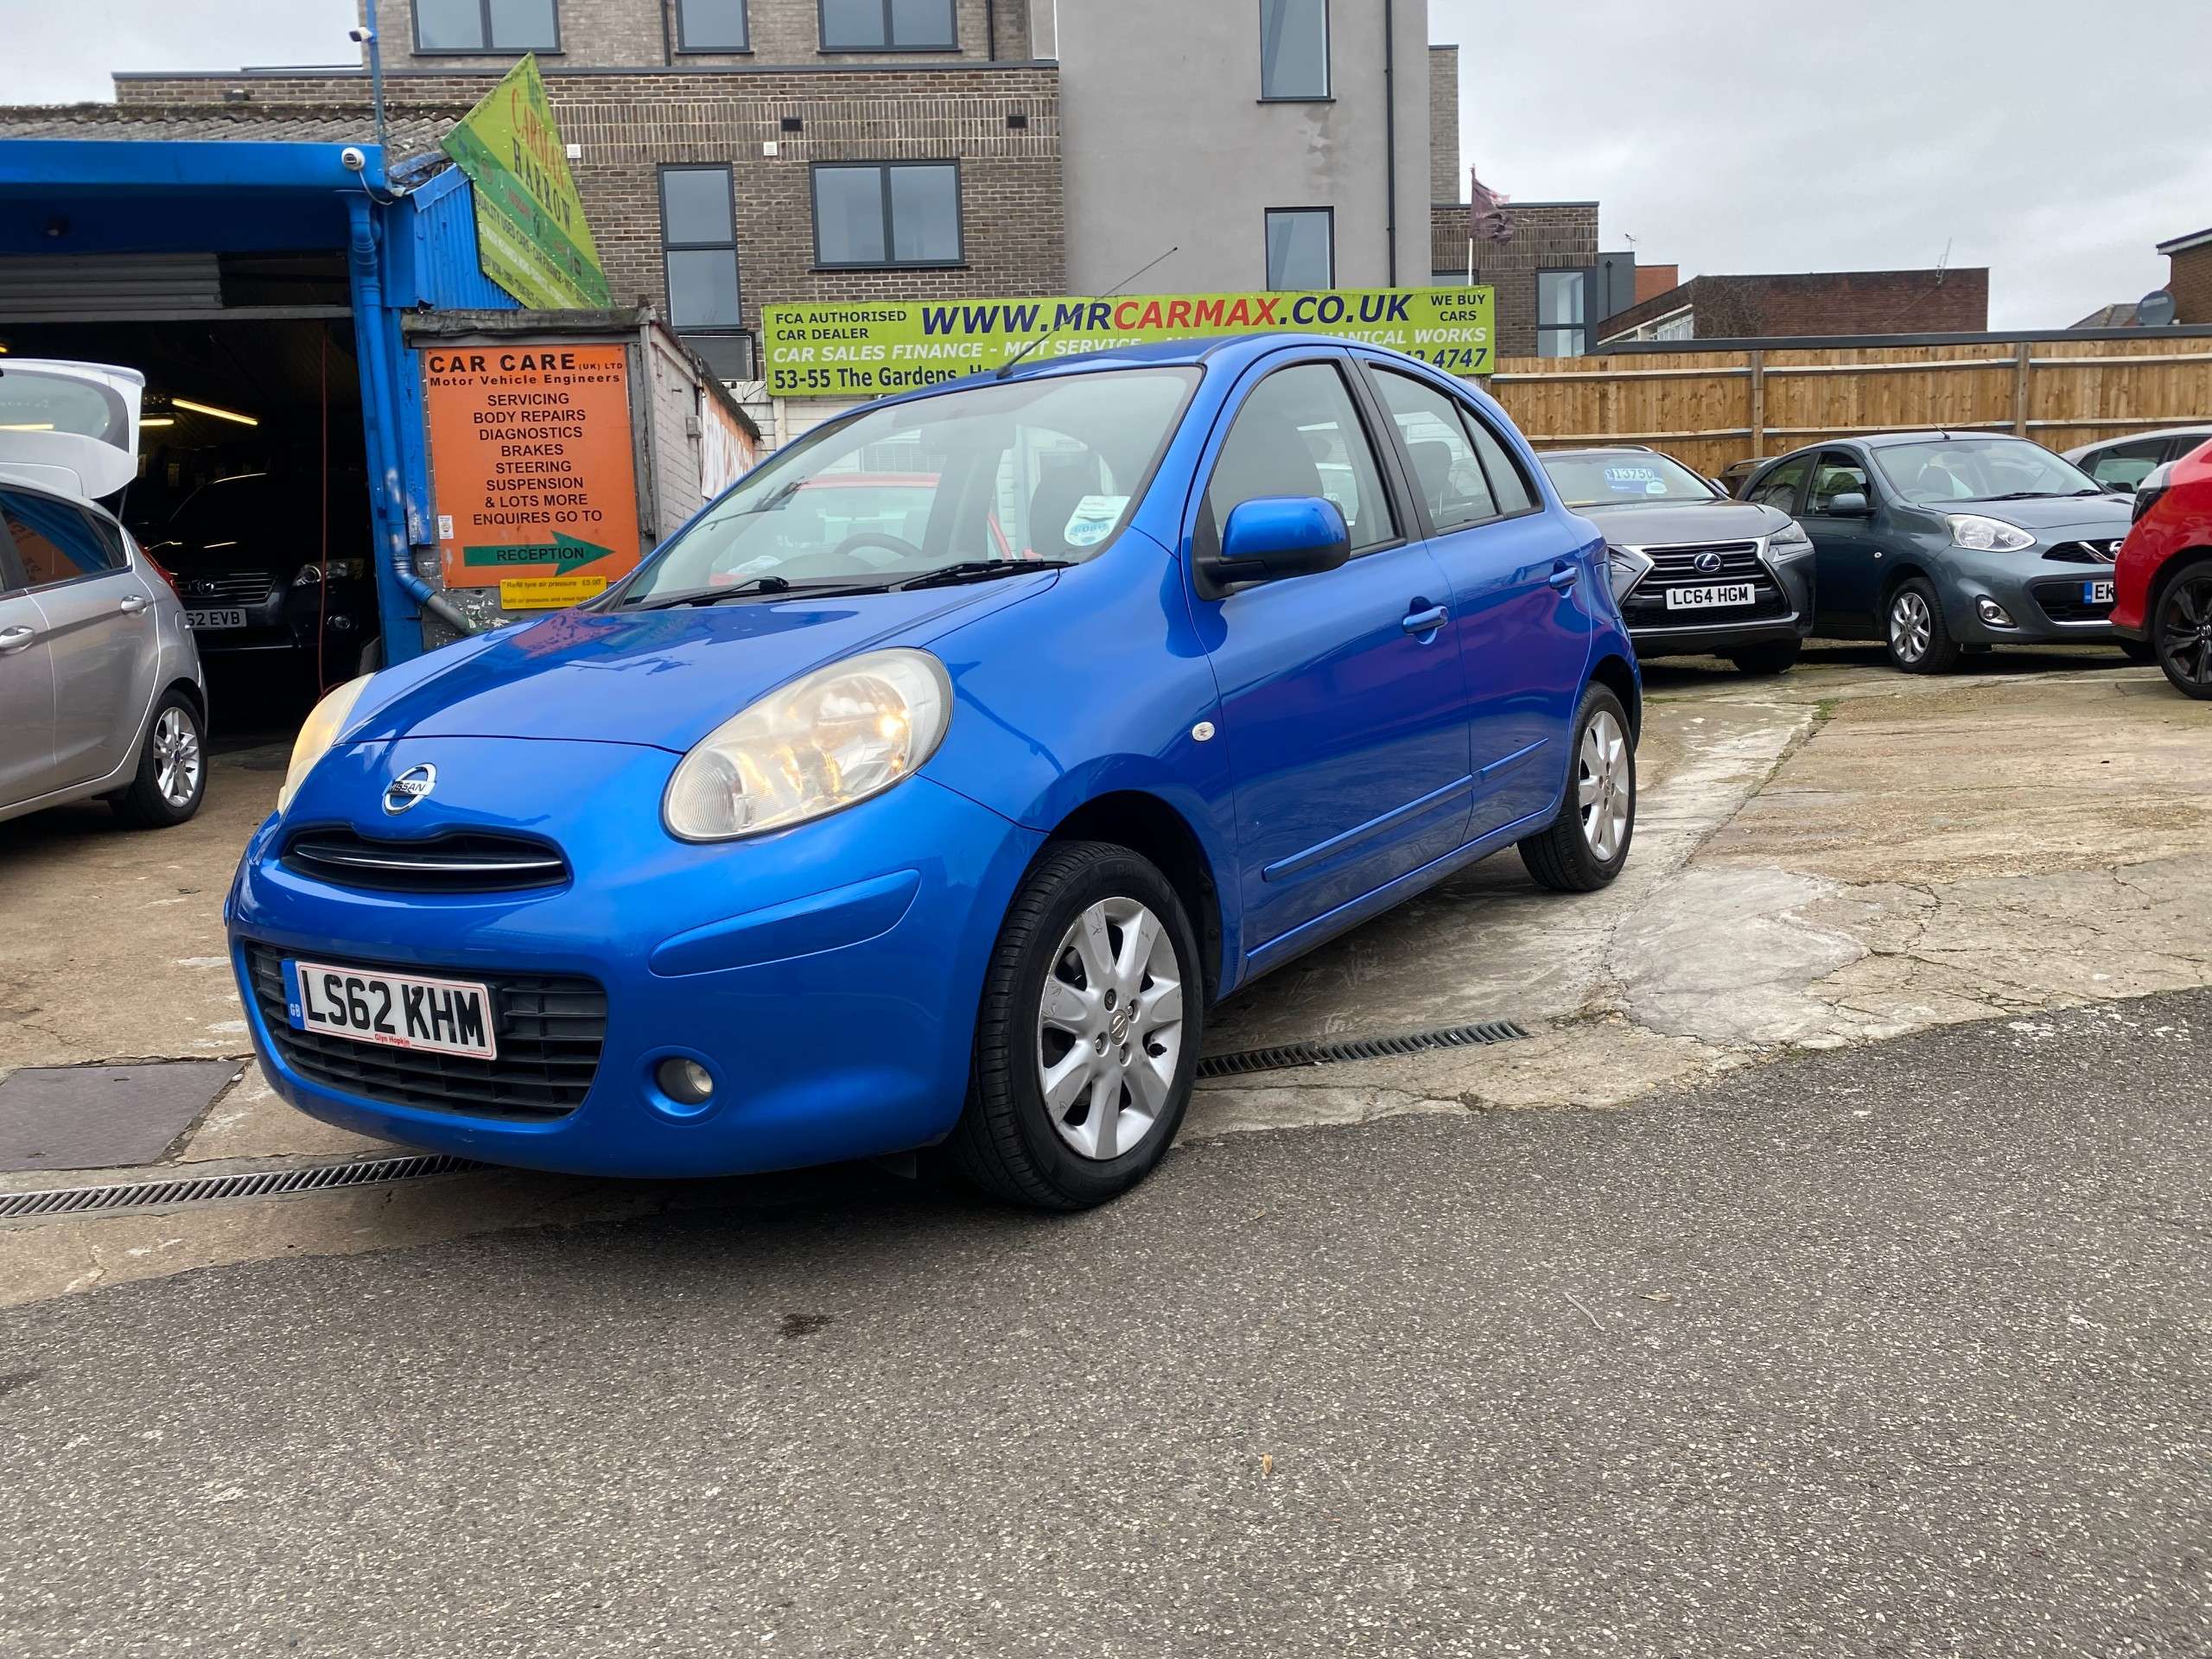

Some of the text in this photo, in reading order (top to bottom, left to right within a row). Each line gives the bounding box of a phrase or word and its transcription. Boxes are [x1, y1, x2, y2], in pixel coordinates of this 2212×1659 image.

[512, 137, 571, 233] HARROW
[1430, 294, 1486, 306] WE BUY
[776, 310, 907, 325] FCA AUTHORISED
[921, 294, 1414, 335] WWW.MRCARMAX.CO.UK
[1440, 309, 1478, 322] CARS
[777, 327, 869, 340] CAR DEALER
[1414, 327, 1486, 345] WORKS
[772, 346, 817, 364] CAR
[820, 345, 886, 362] SALES
[891, 342, 983, 361] FINANCE
[1003, 340, 1047, 359] MOT
[1433, 347, 1487, 368] 4747
[429, 355, 486, 373] CAR
[499, 353, 576, 372] CARE
[578, 362, 601, 372] (UK)
[429, 373, 620, 386] Motor Vehicle Engineers
[774, 369, 831, 390] 53-55
[836, 367, 873, 389] The
[878, 365, 957, 387] Gardens
[487, 393, 570, 407] SERVICING
[474, 409, 586, 424] BODY REPAIRS
[479, 426, 583, 442] DIAGNOSTICS
[501, 444, 564, 457] BRAKES
[495, 461, 572, 474] STEERING
[486, 477, 584, 493] SUSPENSION
[485, 493, 588, 509] & LOTS MORE
[474, 510, 603, 526] ENQUIRES GO TO
[496, 547, 585, 562] RECEPTION
[549, 580, 577, 588] pressure
[1673, 586, 1748, 605] LC64 HGM
[209, 611, 240, 626] EVB
[289, 1002, 301, 1018] GB
[302, 969, 486, 1047] LS62 KHM
